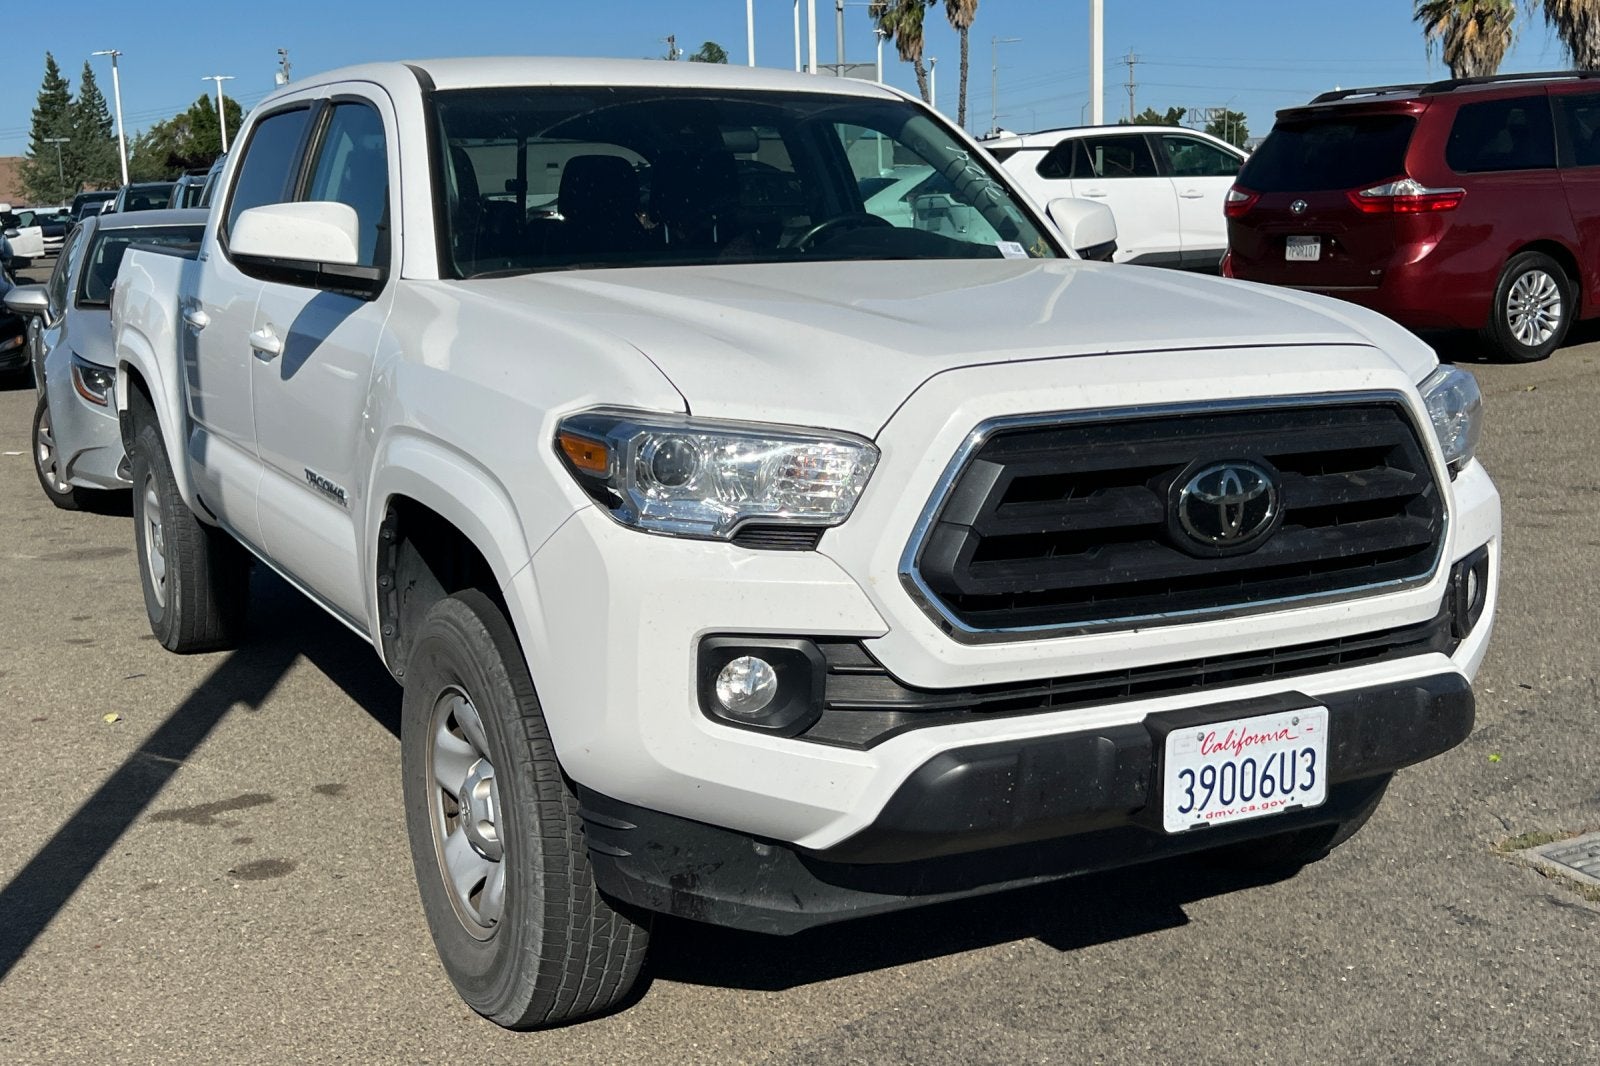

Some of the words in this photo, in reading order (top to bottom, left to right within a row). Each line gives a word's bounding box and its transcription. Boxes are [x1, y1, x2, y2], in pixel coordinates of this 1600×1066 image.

[304, 467, 346, 502] TACOMA
[1201, 727, 1299, 757] California
[1178, 747, 1316, 814] 39006U3
[1205, 799, 1287, 819] dmv.ca.gov
